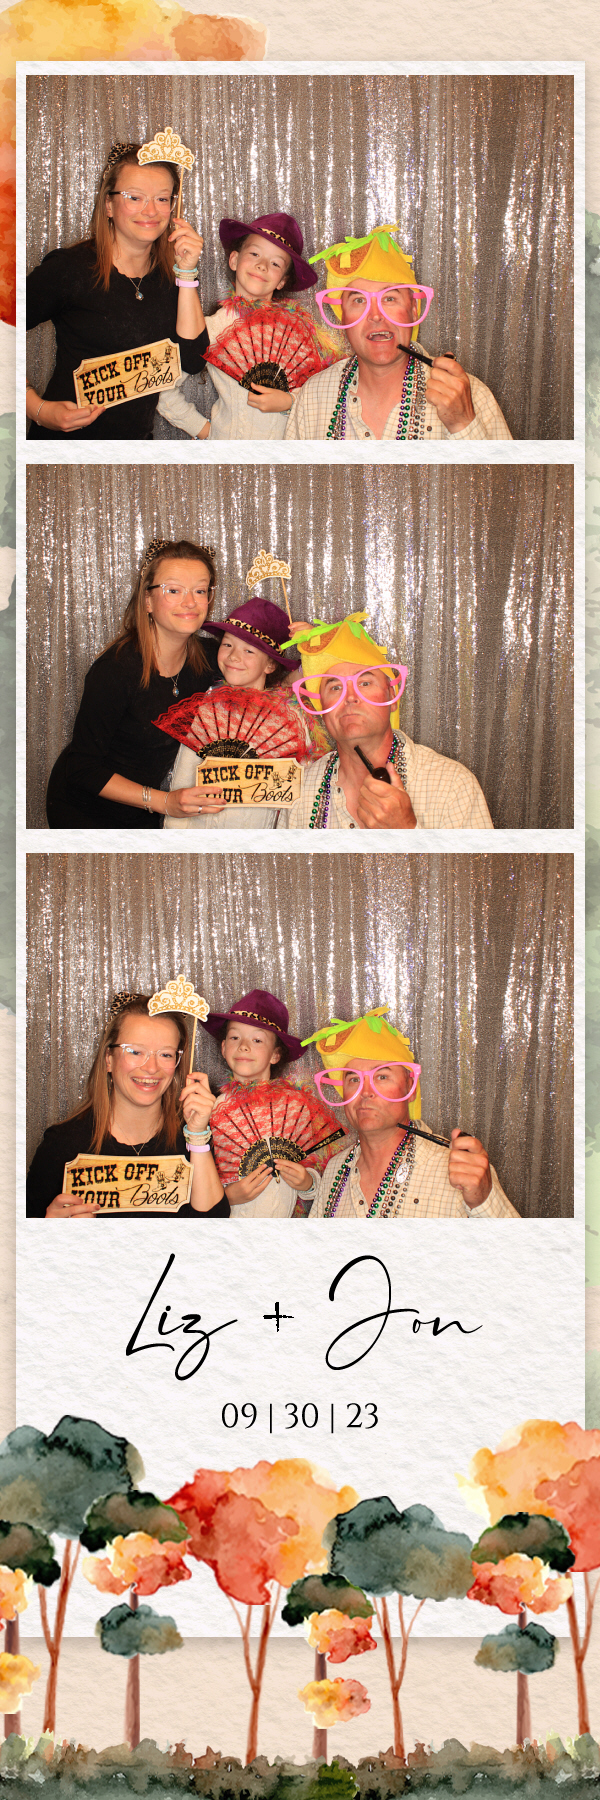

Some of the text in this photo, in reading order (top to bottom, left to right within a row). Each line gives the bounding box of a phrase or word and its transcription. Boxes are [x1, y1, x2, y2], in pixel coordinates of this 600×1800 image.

[80, 352, 151, 390] KICK OFF
[84, 366, 173, 404] YOUR Boots
[201, 764, 274, 784] KICK OFF
[238, 782, 293, 802] Boots
[71, 1163, 159, 1187] KICK OFF
[115, 1183, 179, 1206] Boots
